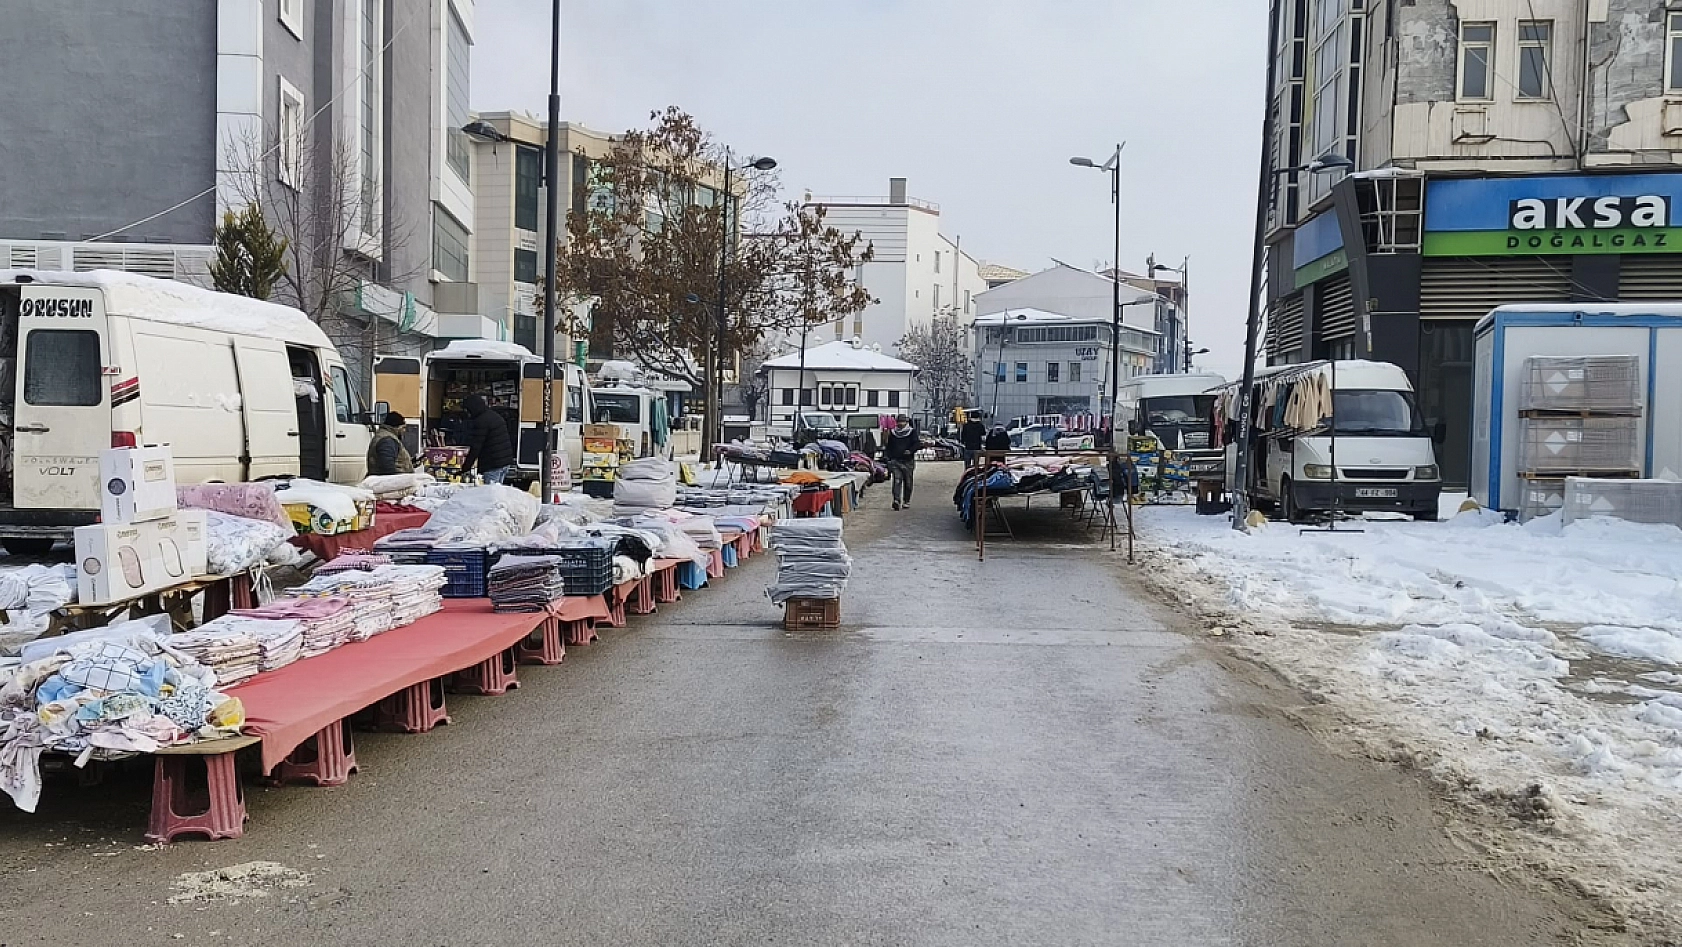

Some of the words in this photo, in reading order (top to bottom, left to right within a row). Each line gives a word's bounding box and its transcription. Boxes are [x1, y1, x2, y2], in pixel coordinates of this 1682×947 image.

[1512, 195, 1667, 230] aksa
[1506, 232, 1668, 249] DOĞALGAZ
[20, 298, 94, 318] ORUSUN
[38, 466, 76, 476] VOLT
